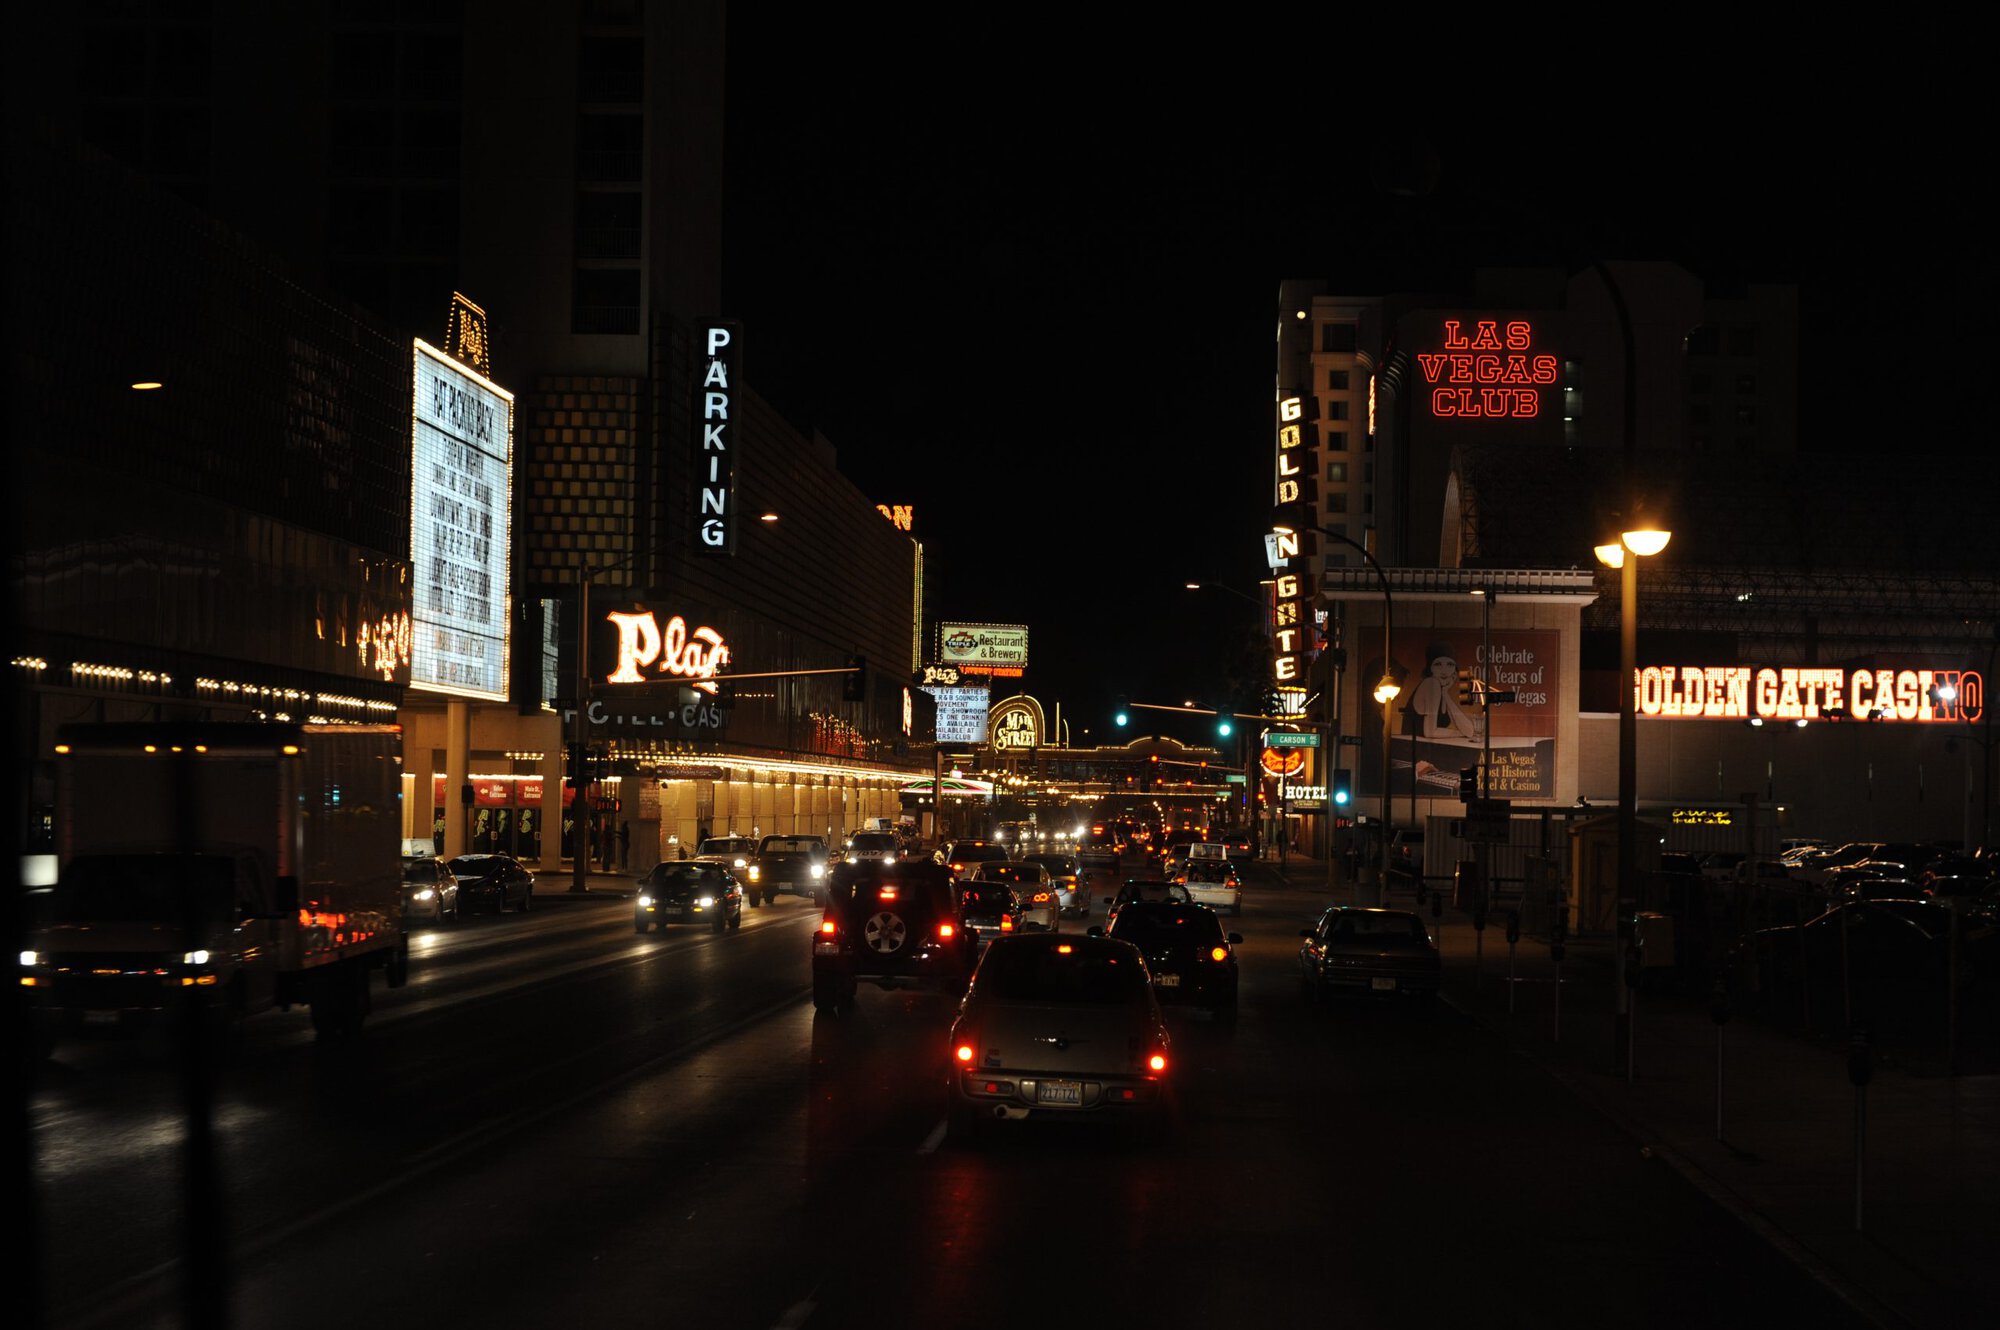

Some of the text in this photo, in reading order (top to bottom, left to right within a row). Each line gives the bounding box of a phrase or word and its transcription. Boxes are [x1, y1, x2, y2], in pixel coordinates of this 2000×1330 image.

[1445, 321, 1531, 350] LAS
[1418, 354, 1557, 384] VEGAS
[1432, 388, 1538, 417] CLUB
[476, 399, 493, 446] BACK
[702, 328, 730, 546] PARKING
[1276, 575, 1297, 680] GATE
[980, 634, 1024, 646] Restaurant
[980, 647, 1022, 661] & Brewery
[1494, 666, 1526, 684] Years
[1530, 666, 1544, 684] of
[1756, 668, 1844, 719] GATE
[1851, 670, 1982, 722] CASINO
[1280, 736, 1306, 744] CARSON
[1491, 752, 1507, 764] Las
[1502, 765, 1537, 778] Historic
[1285, 786, 1327, 800] HOTEL
[1500, 778, 1508, 790] &
[1510, 778, 1541, 791] Casino
